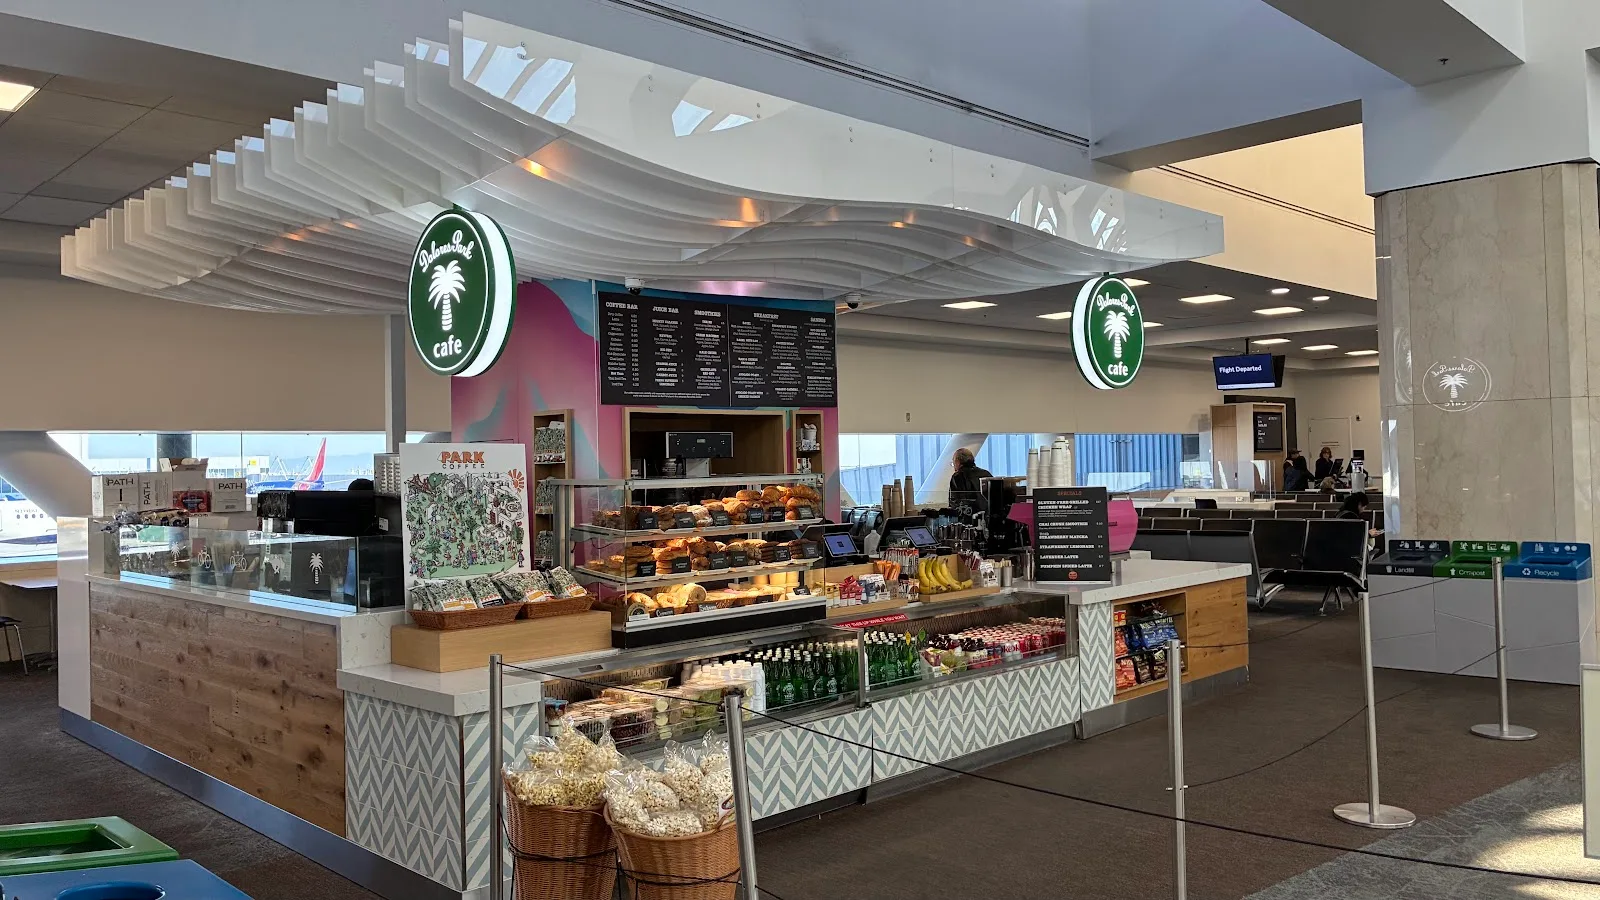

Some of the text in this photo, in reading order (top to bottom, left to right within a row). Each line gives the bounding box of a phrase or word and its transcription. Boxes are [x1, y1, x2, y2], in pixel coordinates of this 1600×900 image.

[419, 229, 474, 273] Dolores Park
[1096, 292, 1135, 316] Dolores Park
[433, 334, 462, 358] cafe
[1108, 361, 1128, 376] cafe
[1236, 365, 1262, 373] Departed
[441, 451, 485, 463] PARK
